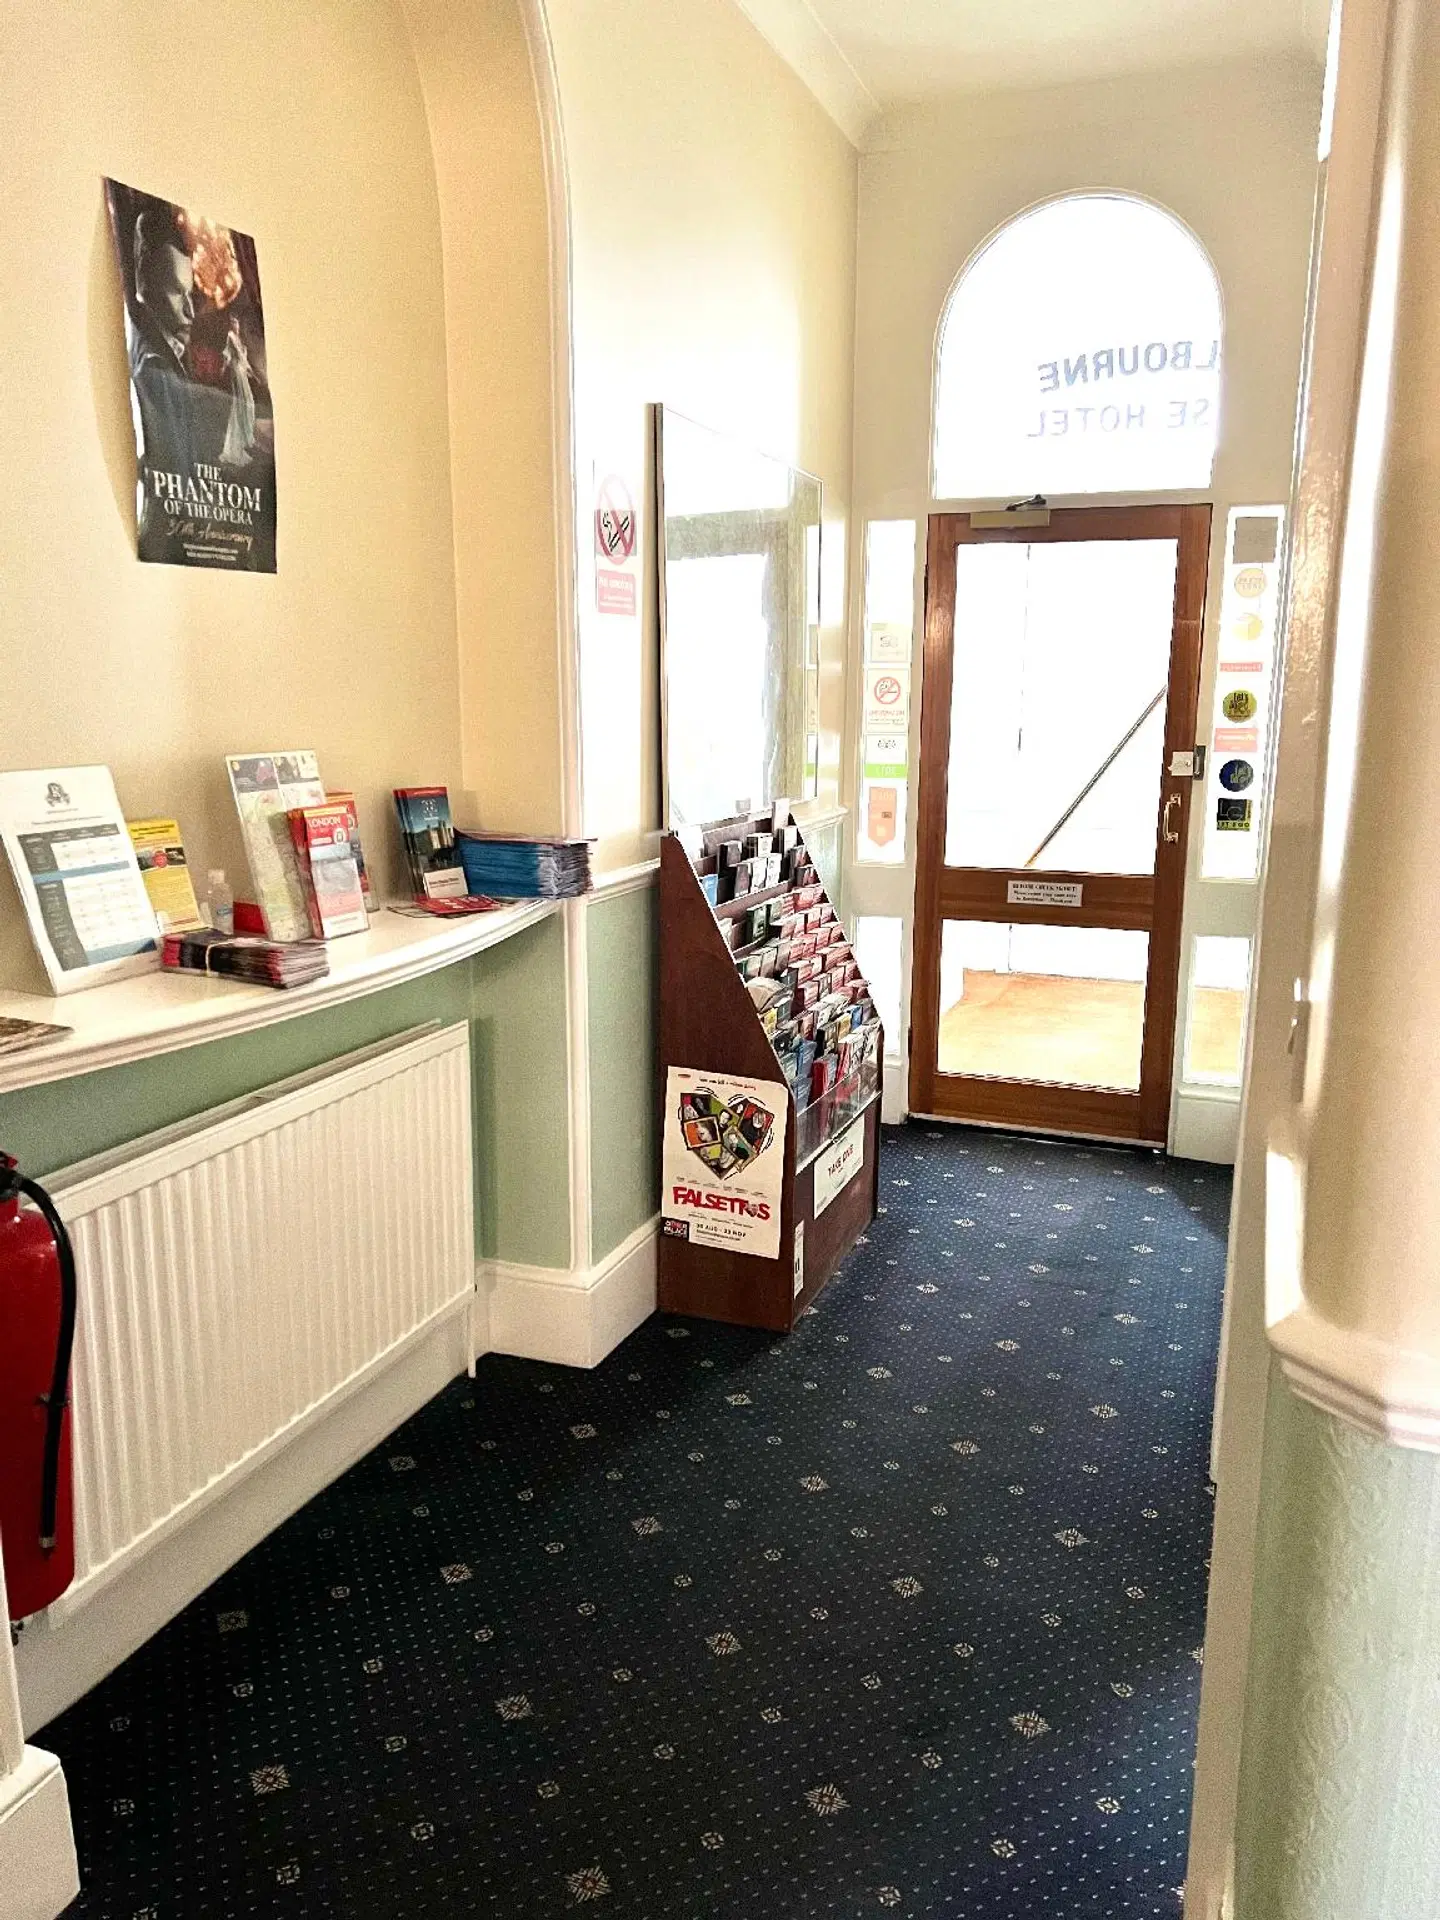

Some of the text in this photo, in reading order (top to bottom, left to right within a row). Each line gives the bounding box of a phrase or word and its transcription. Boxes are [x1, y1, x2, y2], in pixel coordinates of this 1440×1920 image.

[194, 463, 222, 480] THE
[152, 470, 262, 512] PHANTOM
[163, 498, 253, 526] OF THE OPERA
[307, 815, 341, 828] LONDON
[827, 1143, 854, 1177] TAKE ONE
[733, 1230, 747, 1238] NOV
